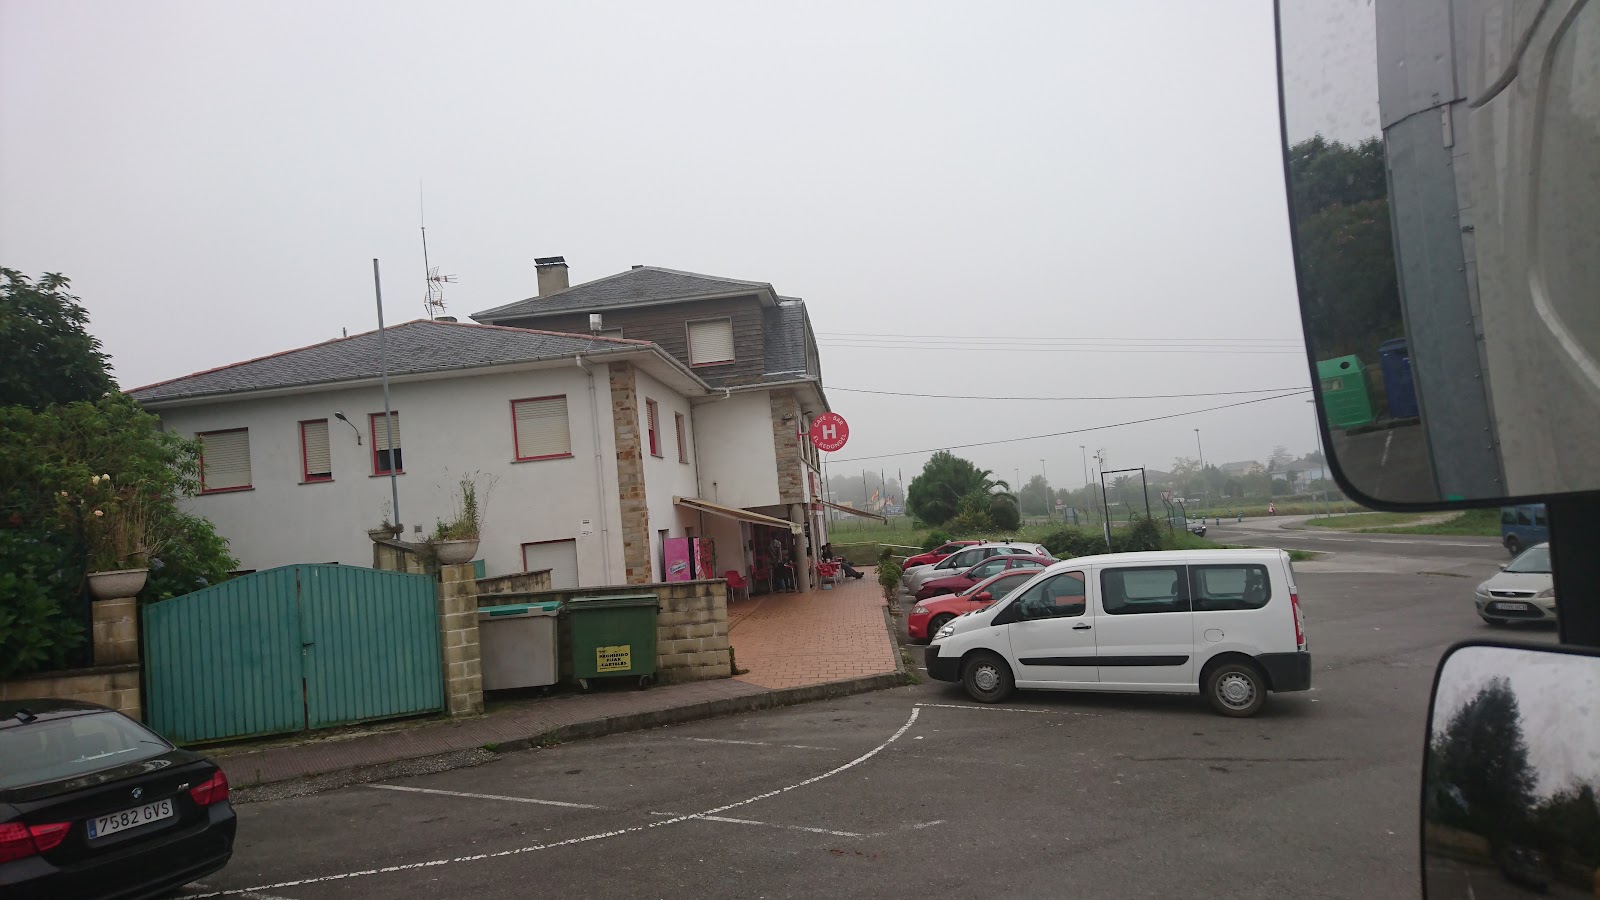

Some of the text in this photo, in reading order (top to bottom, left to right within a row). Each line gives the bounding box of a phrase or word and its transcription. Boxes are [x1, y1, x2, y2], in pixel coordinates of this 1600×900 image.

[832, 415, 843, 426] BAR
[822, 424, 837, 440] H
[813, 433, 847, 449] EL REDONDEL
[99, 801, 170, 833] 7582 GVS
